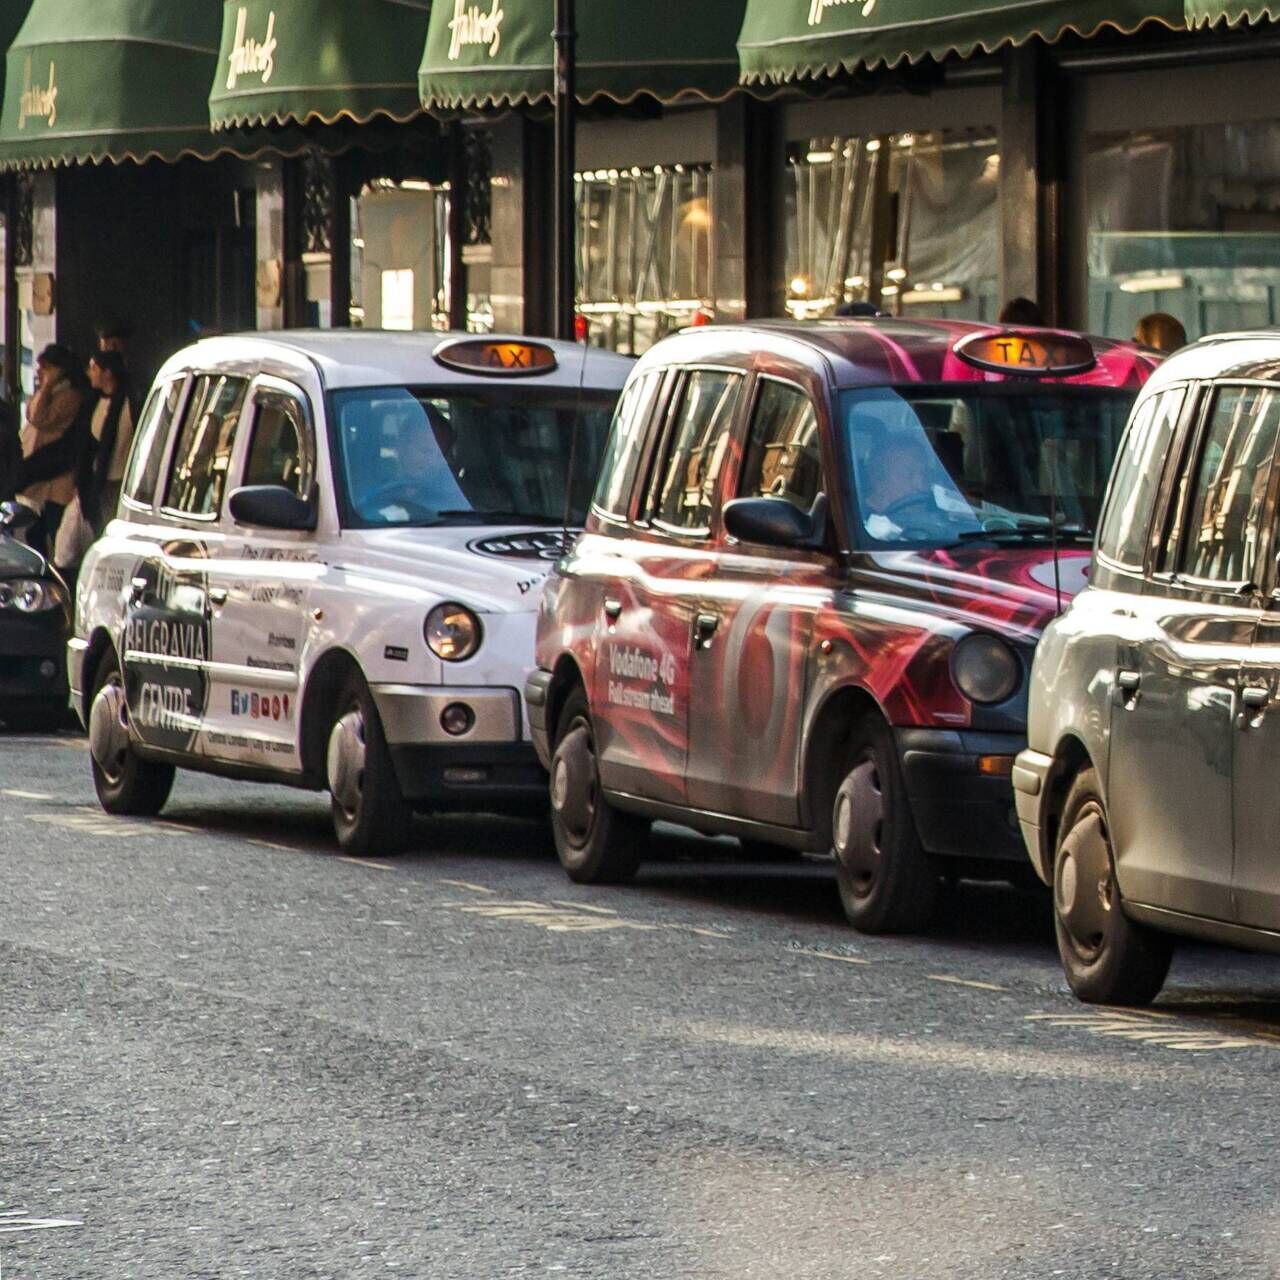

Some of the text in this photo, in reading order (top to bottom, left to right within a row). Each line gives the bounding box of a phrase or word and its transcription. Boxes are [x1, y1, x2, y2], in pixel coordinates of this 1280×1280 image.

[484, 347, 535, 369] AXI
[126, 618, 205, 666] BELGRAVIA
[609, 643, 675, 686] Vodafone 4G
[138, 681, 193, 731] CENTRE
[608, 680, 622, 705] Full
